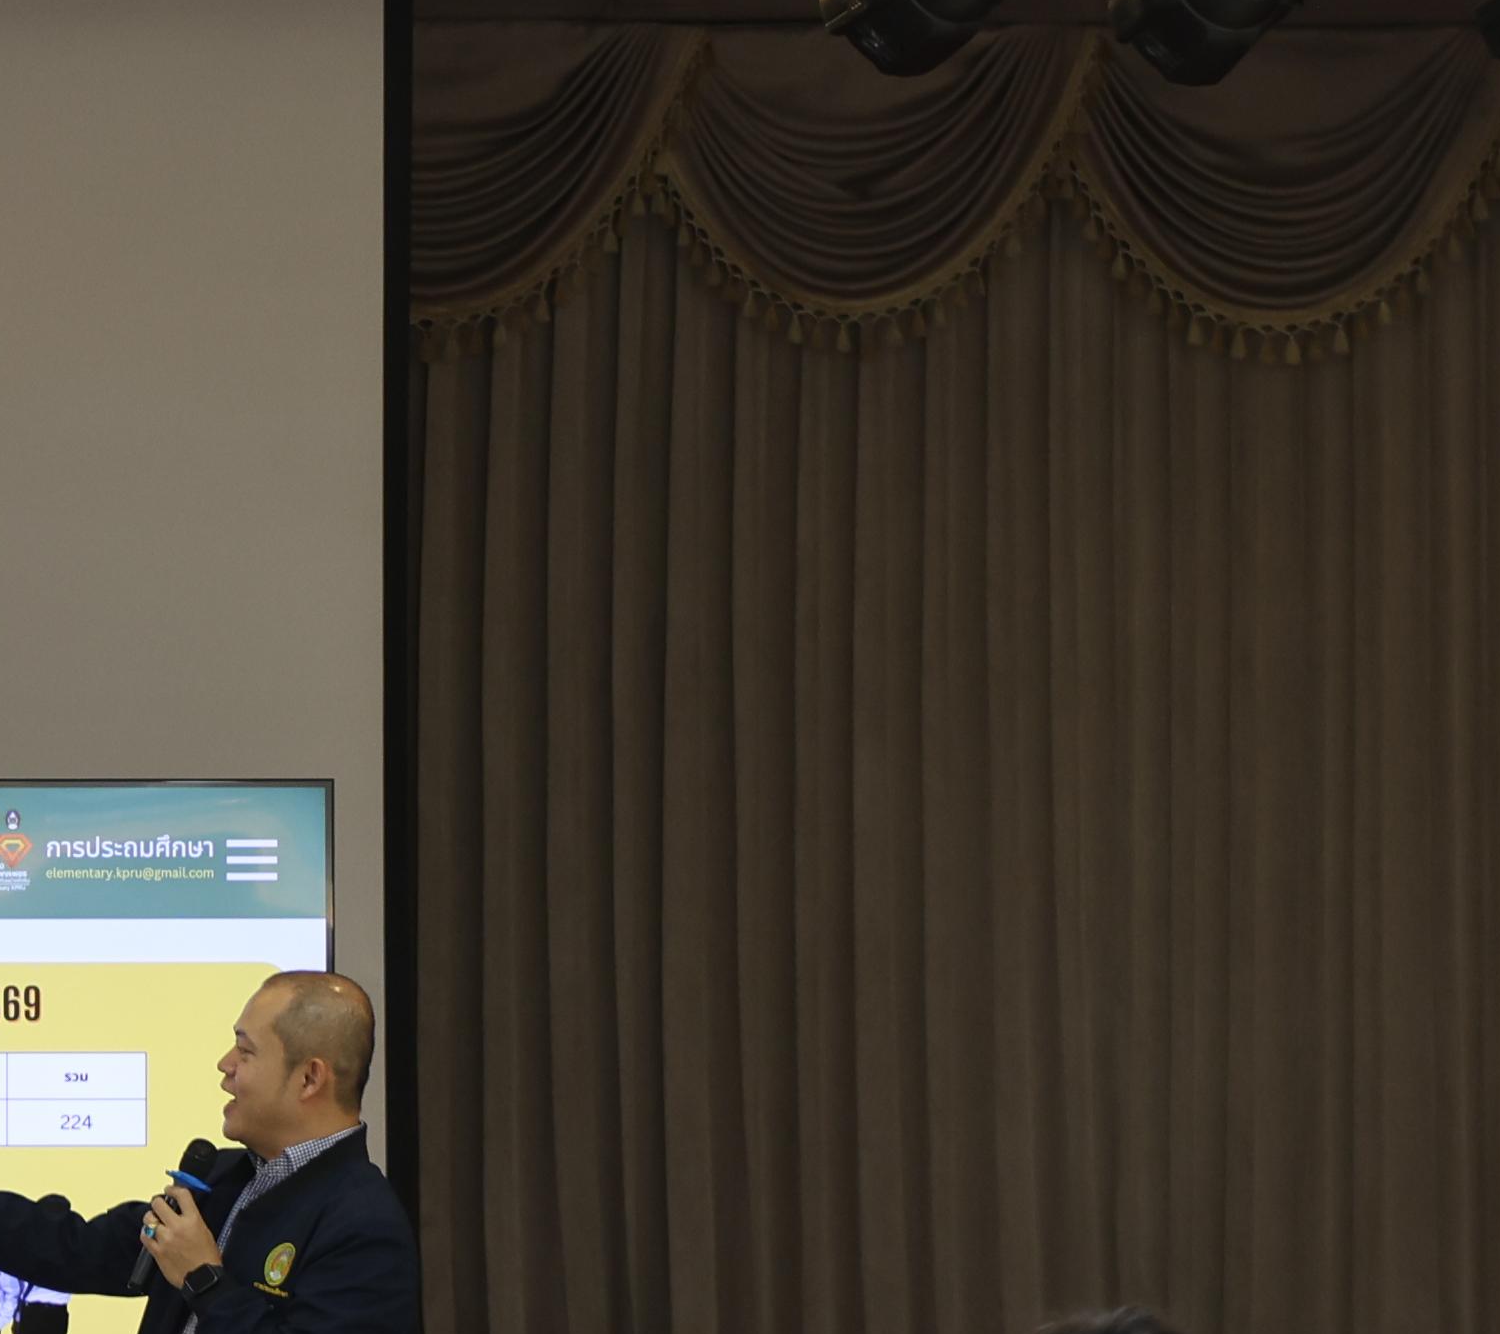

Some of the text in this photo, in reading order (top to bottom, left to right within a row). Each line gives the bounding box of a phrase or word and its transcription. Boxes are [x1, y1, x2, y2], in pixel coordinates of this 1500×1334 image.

[46, 834, 214, 858] การประถมศึกษา
[45, 867, 215, 881] elementary.kpru@gmail.com
[64, 1071, 89, 1083] รวม
[59, 1114, 93, 1131] 224
